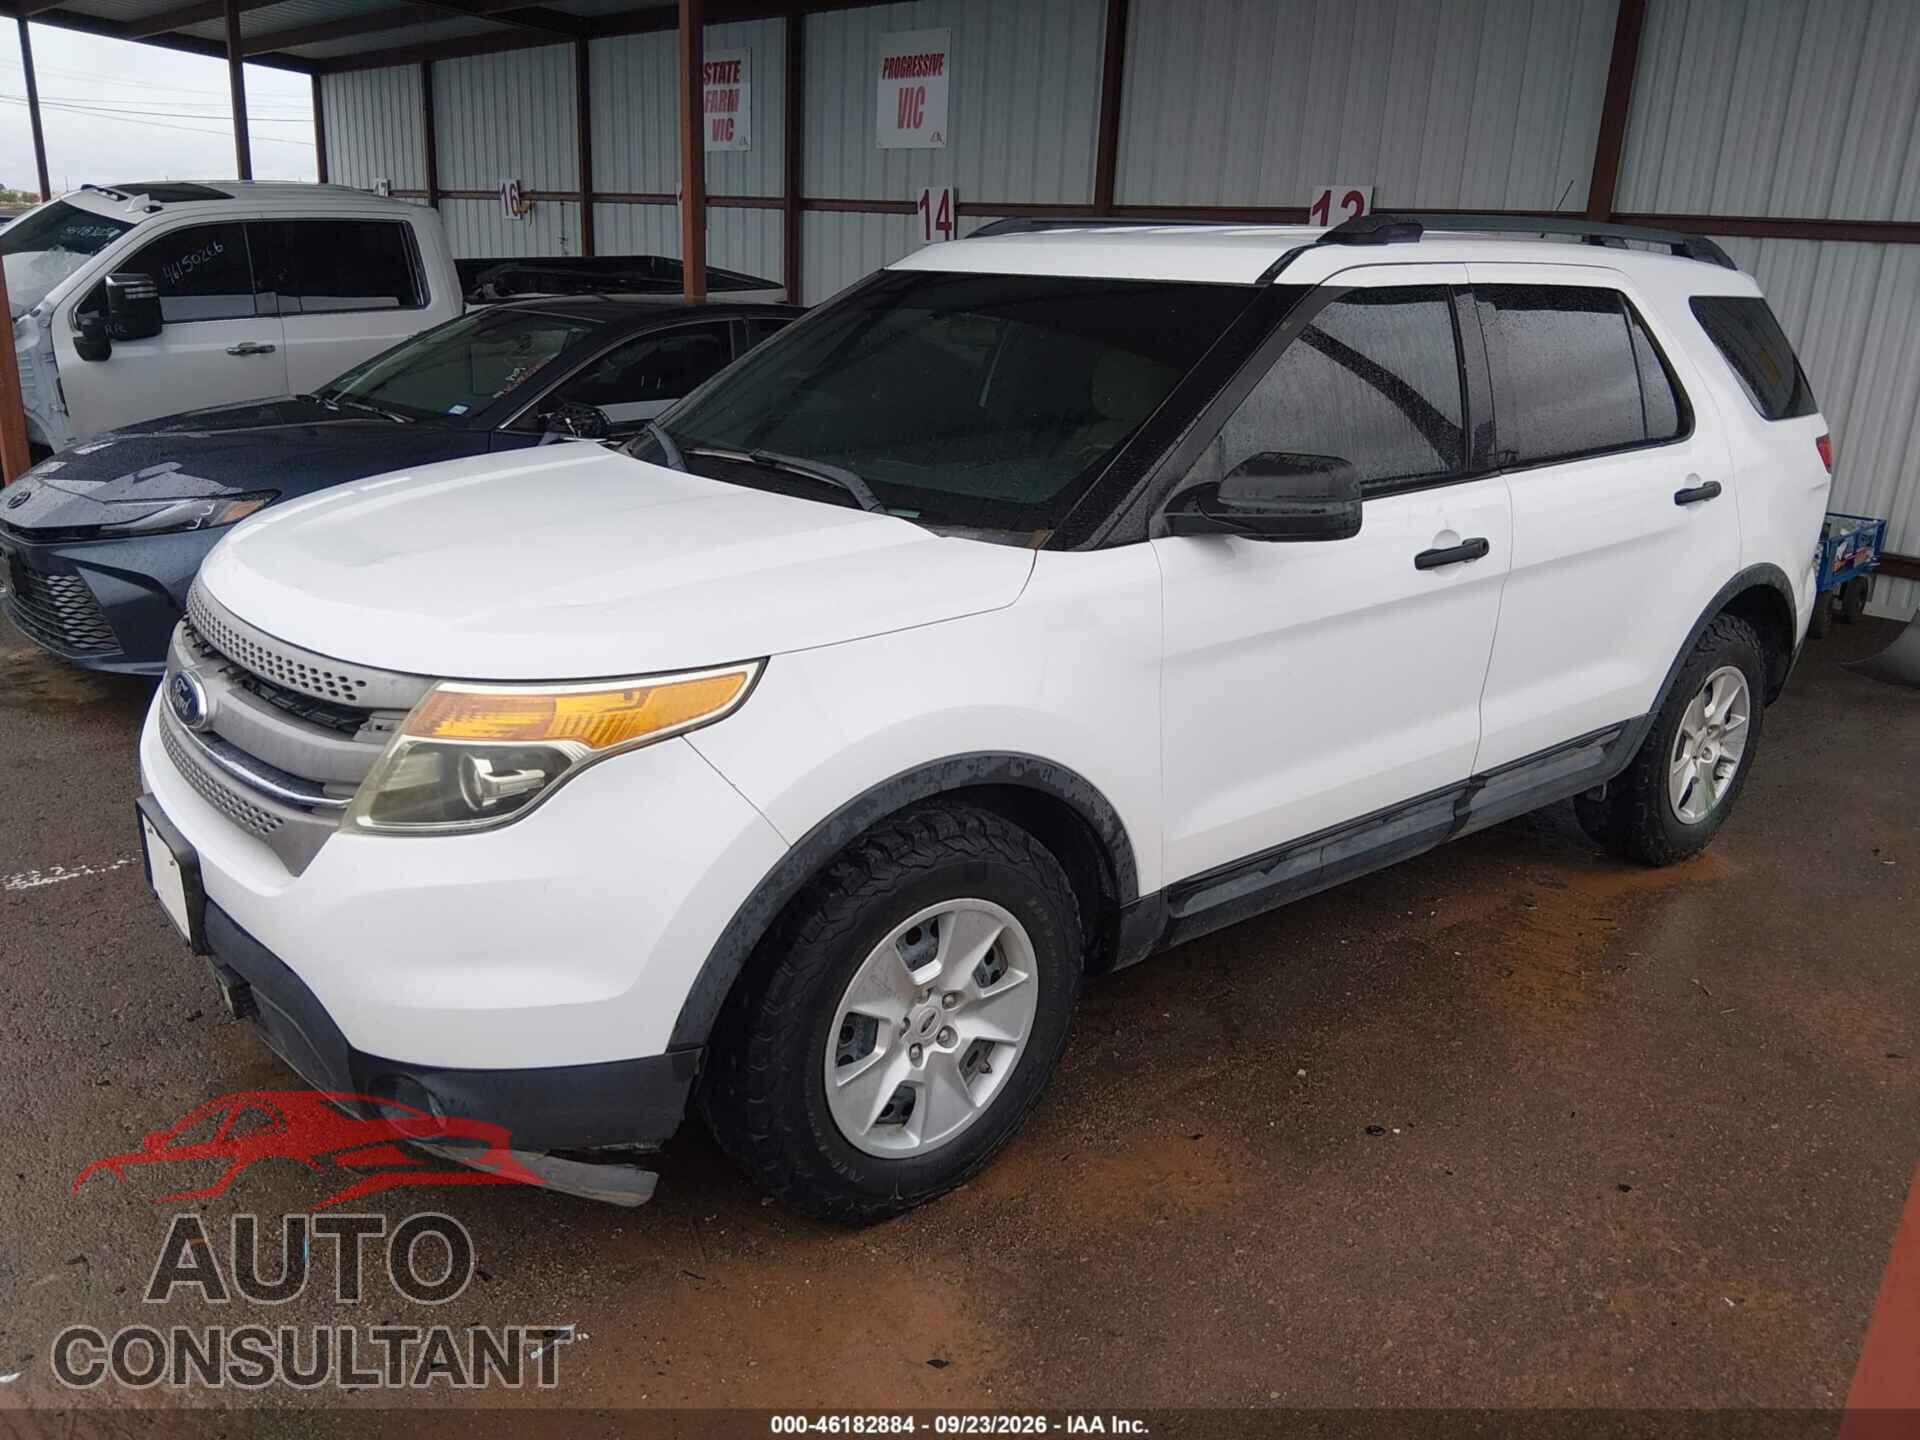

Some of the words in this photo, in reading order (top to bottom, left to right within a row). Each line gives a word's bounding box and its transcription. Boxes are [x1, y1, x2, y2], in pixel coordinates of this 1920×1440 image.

[704, 61, 741, 85] STATE
[882, 53, 945, 80] PROGRESSIVE
[704, 89, 740, 112] FARM
[897, 86, 926, 129] VIC
[712, 118, 734, 142] VIC
[501, 181, 518, 217] 16
[918, 188, 952, 241] 14
